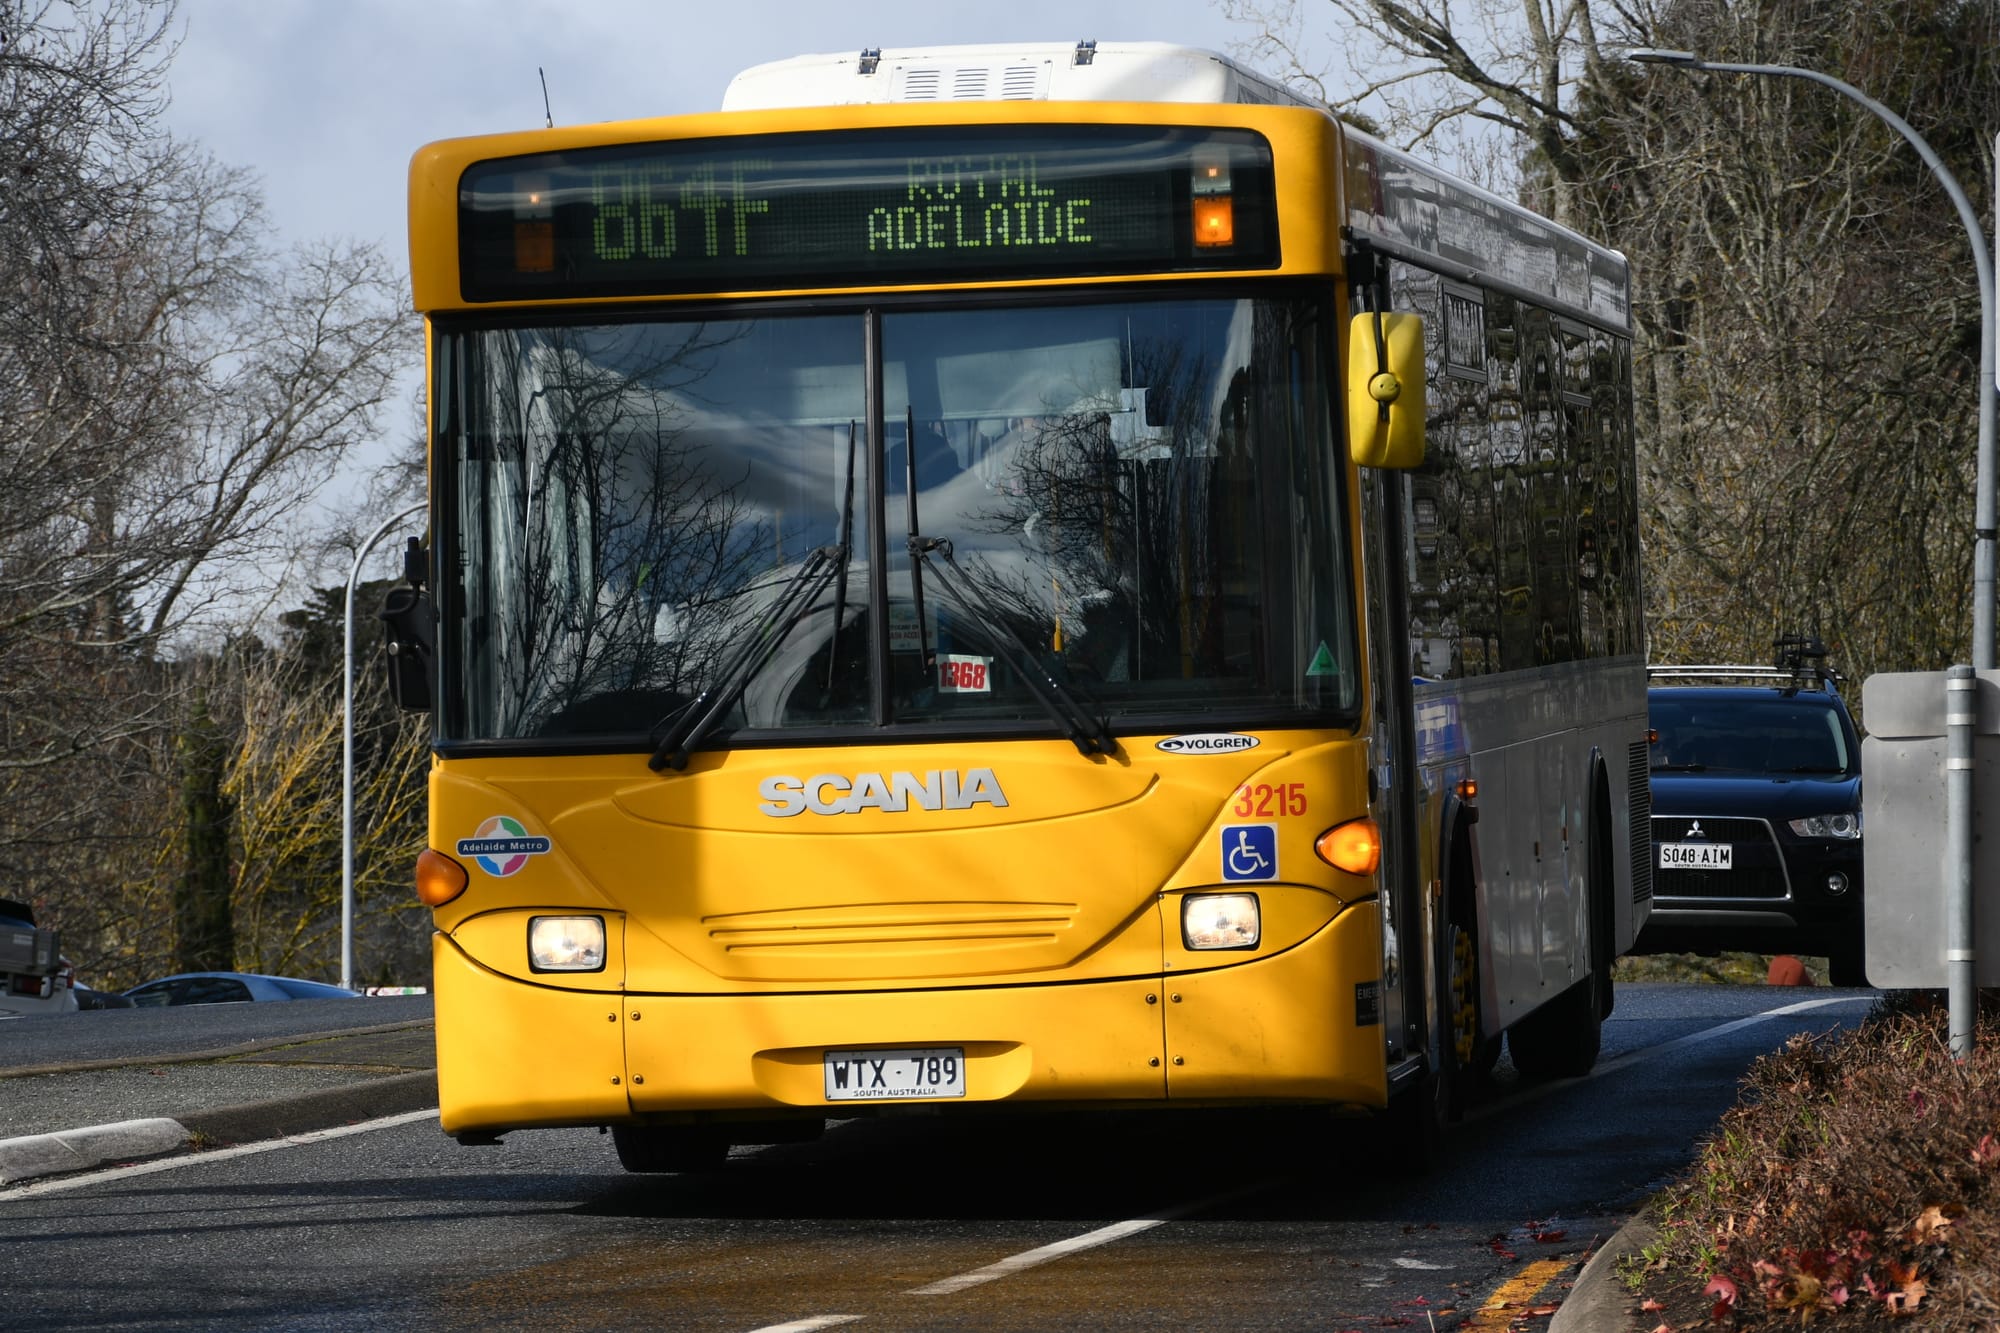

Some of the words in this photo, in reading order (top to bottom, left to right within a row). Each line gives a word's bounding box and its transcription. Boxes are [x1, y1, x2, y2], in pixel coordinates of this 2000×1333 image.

[907, 155, 1054, 199] ROYAL
[592, 160, 772, 259] 864F
[868, 199, 1092, 250] ADELAIDE
[939, 661, 986, 690] 1368
[1185, 737, 1252, 749] VOLGREN
[758, 768, 1009, 817] SCANIA
[1234, 783, 1307, 817] 3215
[463, 841, 505, 852] Adelaide
[510, 841, 542, 851] Metro
[1701, 848, 1730, 864] AIM
[832, 1058, 886, 1089] WTX
[911, 1056, 957, 1085] 789
[887, 1088, 937, 1096] AUSTRALIA
